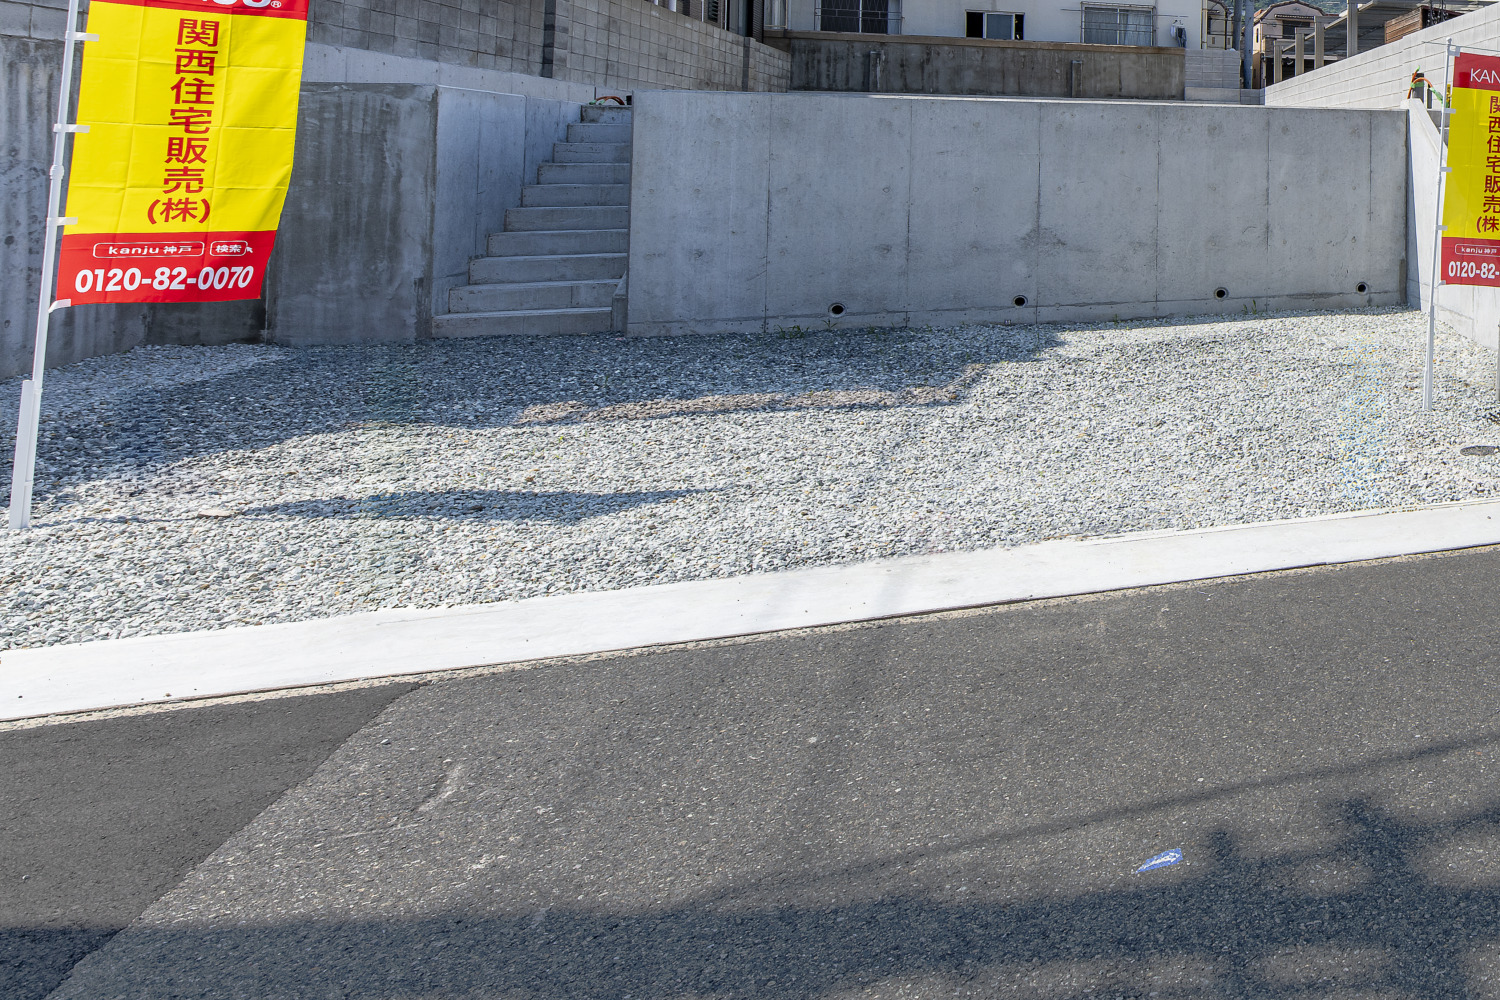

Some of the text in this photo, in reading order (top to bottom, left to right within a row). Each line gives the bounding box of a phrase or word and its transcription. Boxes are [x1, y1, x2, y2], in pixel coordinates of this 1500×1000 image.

[147, 17, 220, 225] 関西住宅販売(株)
[108, 245, 192, 255] kanju 神戸
[215, 244, 242, 254] 検索
[75, 265, 254, 293] 0120-82-0070
